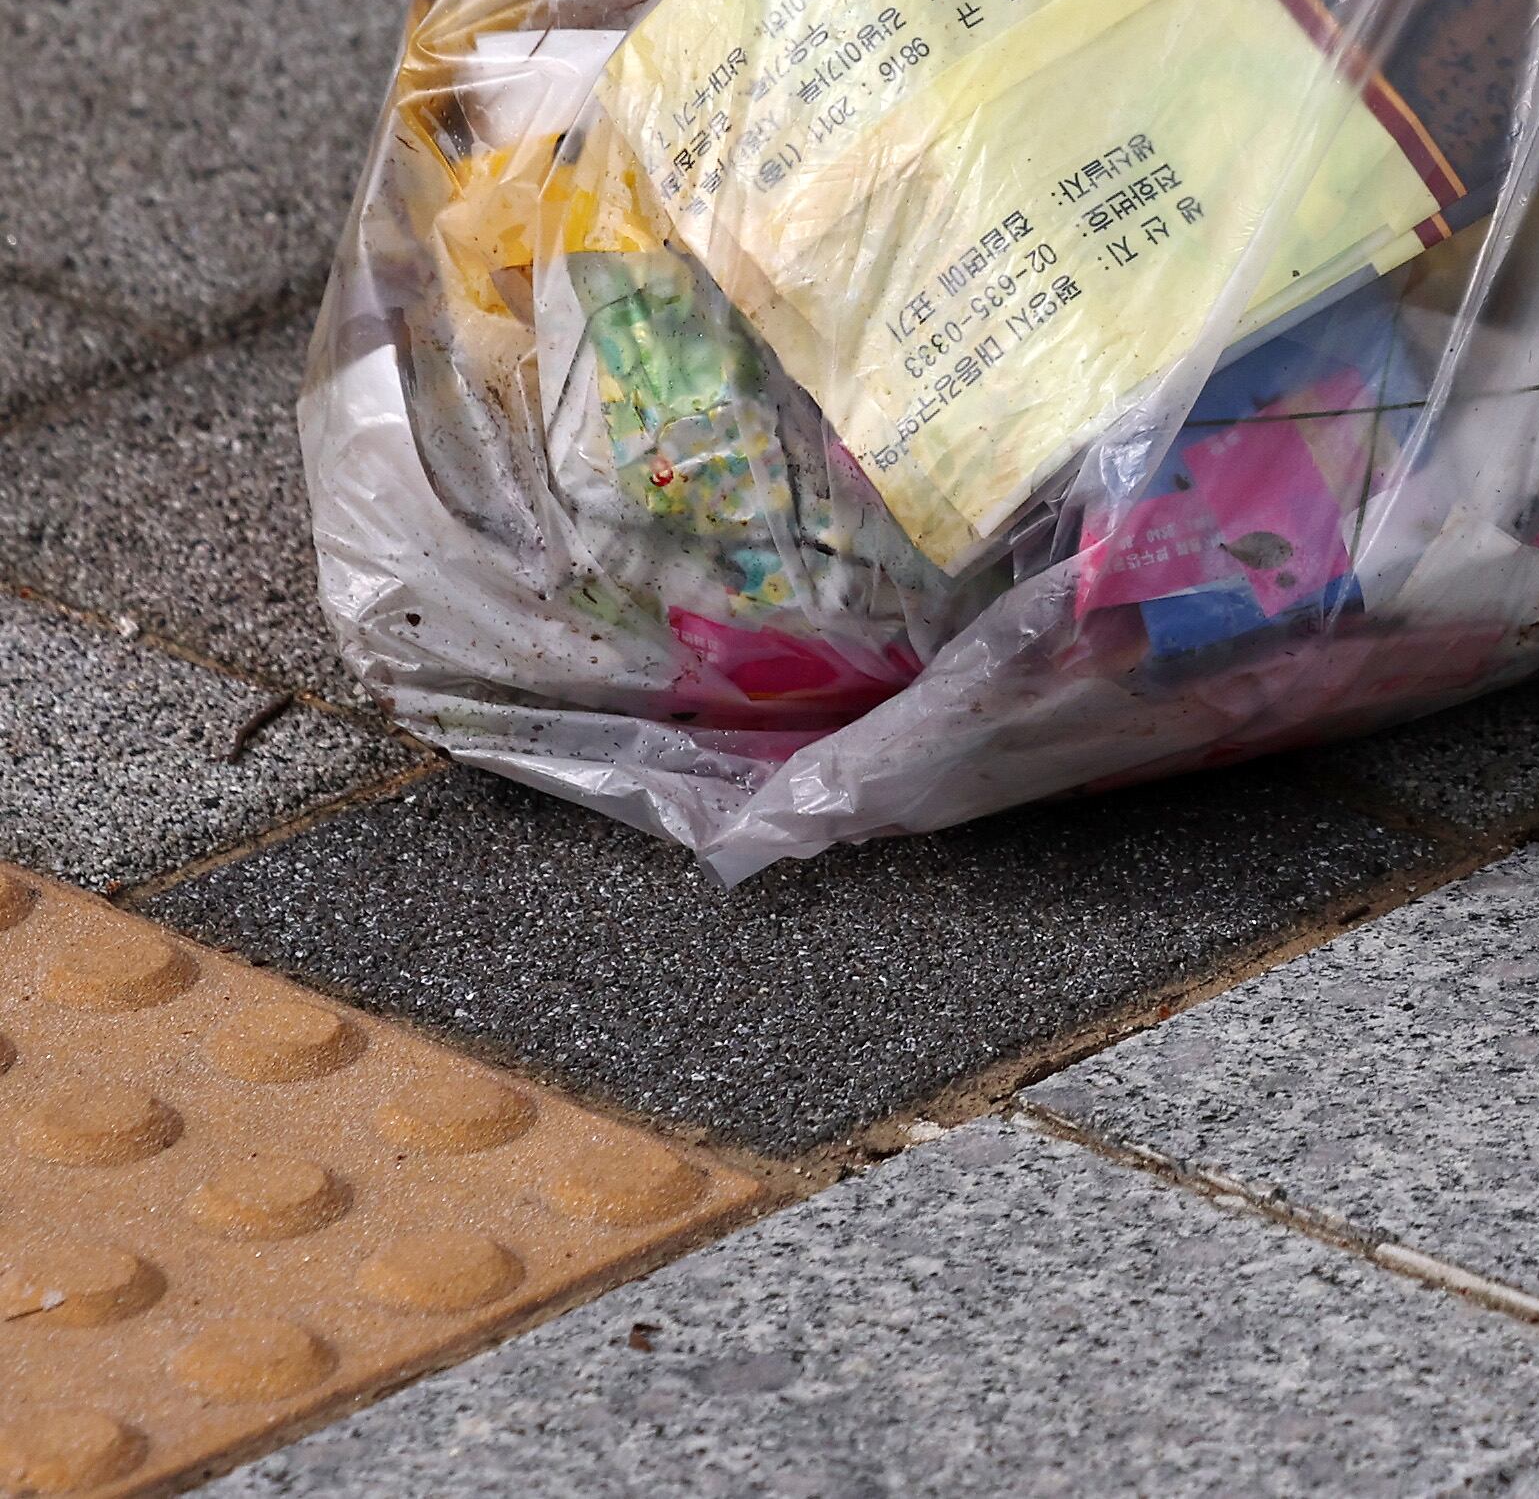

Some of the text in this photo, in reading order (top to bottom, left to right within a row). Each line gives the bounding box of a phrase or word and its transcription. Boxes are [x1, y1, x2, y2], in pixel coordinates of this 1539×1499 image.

[956, 1, 984, 29] 규
[878, 37, 930, 84] 9816
[807, 96, 856, 144] 2011
[1140, 215, 1170, 246] 산
[1176, 196, 1204, 225] 생
[886, 134, 1155, 344] 생산날자: 접합면에 표기
[1097, 234, 1139, 271] 지:
[903, 163, 1183, 379] 전화번호: 02-635-0333
[1005, 275, 1082, 343] 평양시
